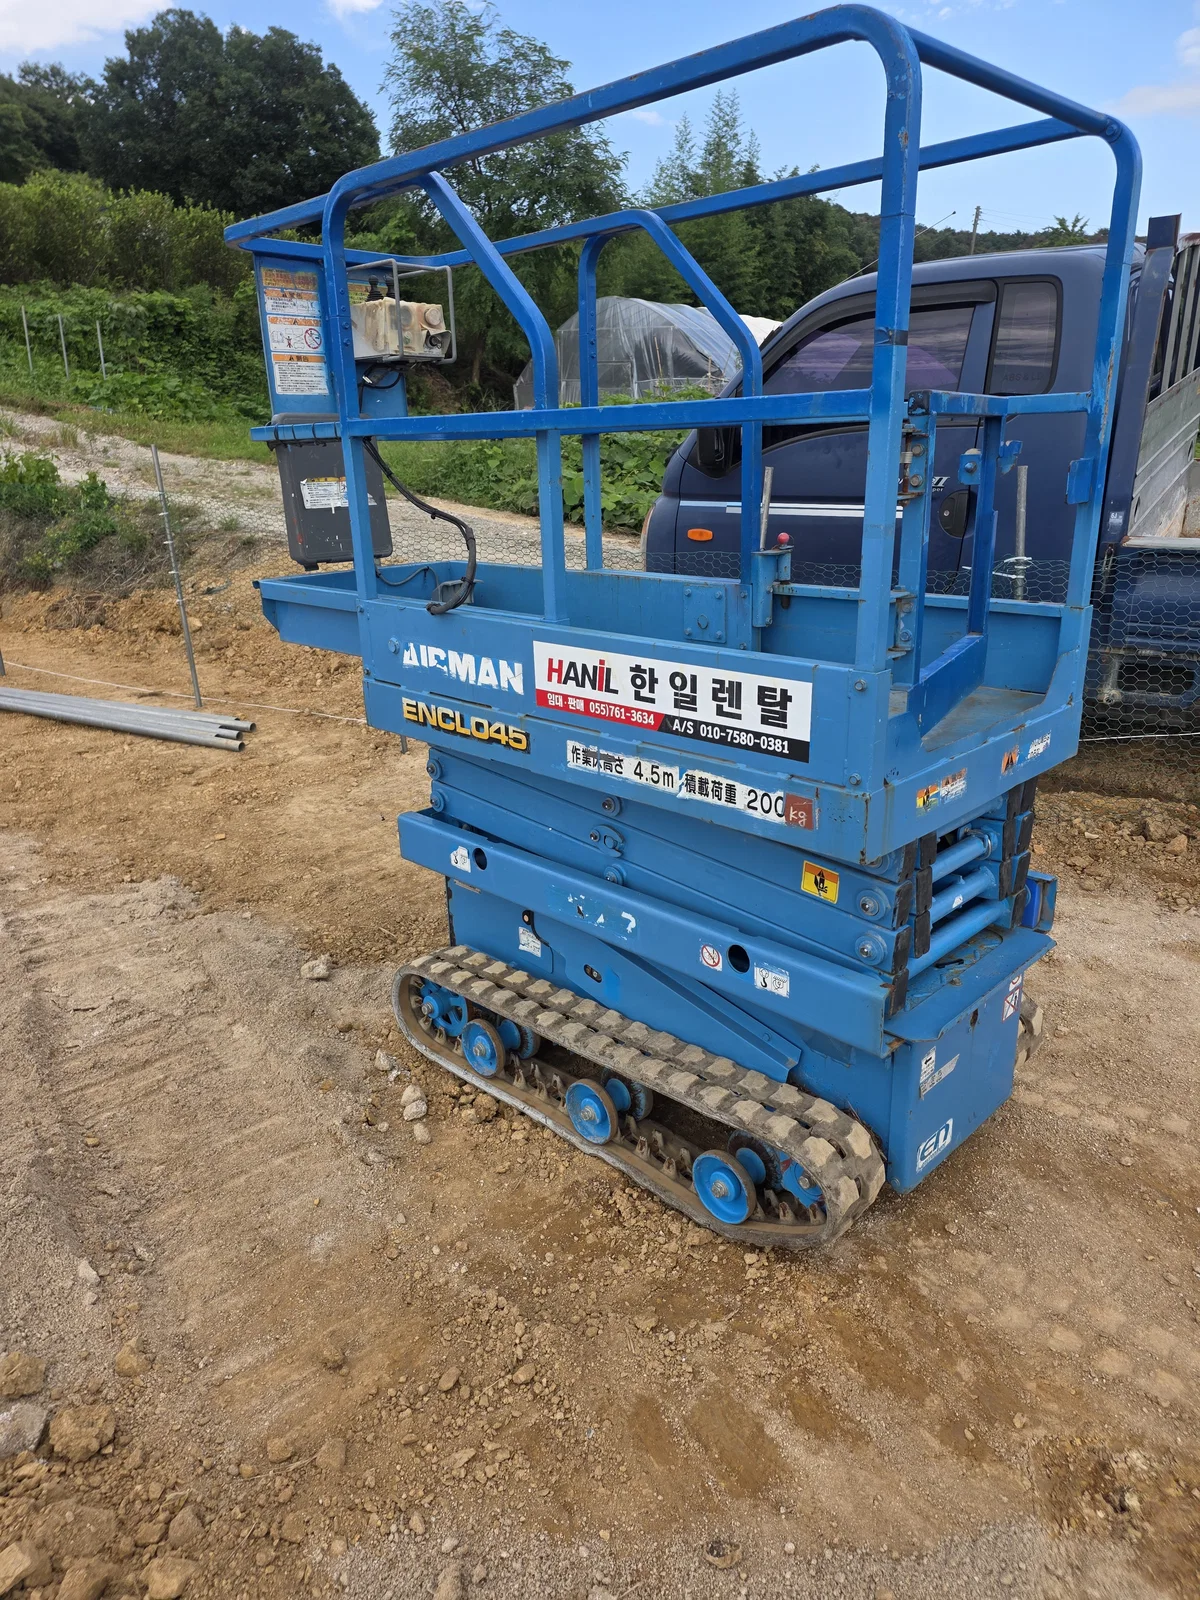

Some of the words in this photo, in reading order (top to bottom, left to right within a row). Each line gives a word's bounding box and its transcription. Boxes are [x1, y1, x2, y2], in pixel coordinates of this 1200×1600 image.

[403, 642, 524, 695] AIRMAN
[589, 702, 654, 726] 055)761-3634
[629, 664, 793, 730] 한일렌탈
[672, 719, 694, 734] A/S
[700, 724, 789, 754] 010-7580-0381
